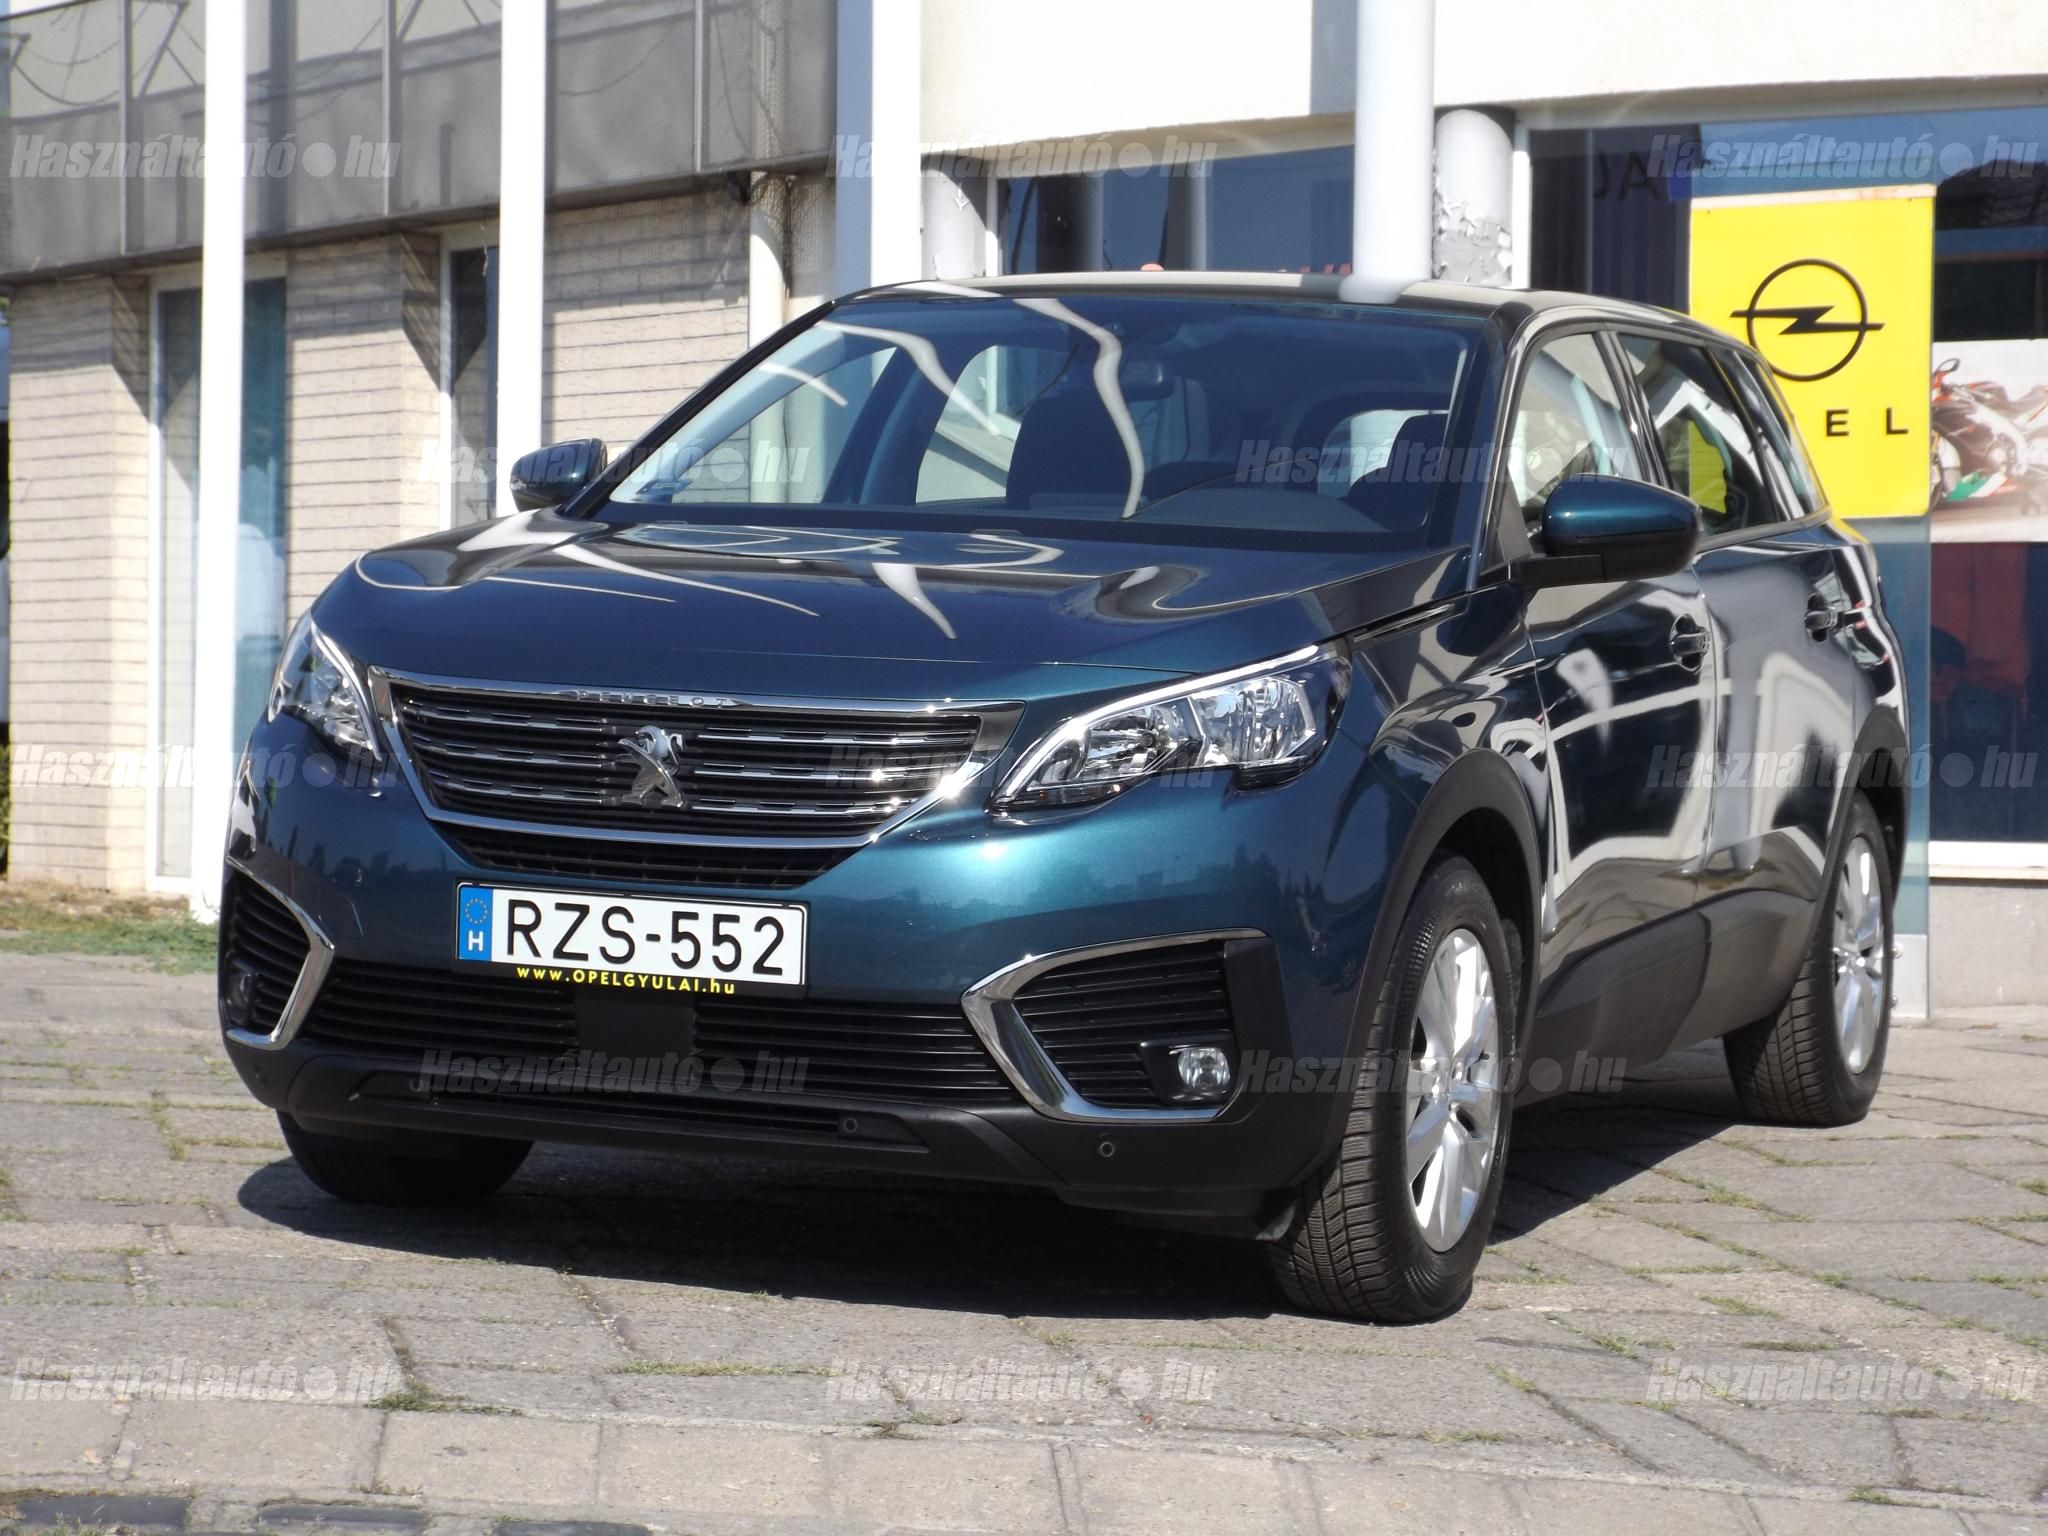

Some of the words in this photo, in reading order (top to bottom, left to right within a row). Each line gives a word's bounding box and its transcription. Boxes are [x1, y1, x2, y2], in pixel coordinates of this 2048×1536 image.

[1826, 407, 1909, 437] EL
[577, 689, 727, 709] PEUGEOT
[467, 930, 484, 952] H
[507, 898, 785, 977] RZS-552
[516, 966, 736, 995] www.OPELGYULAI.hu
